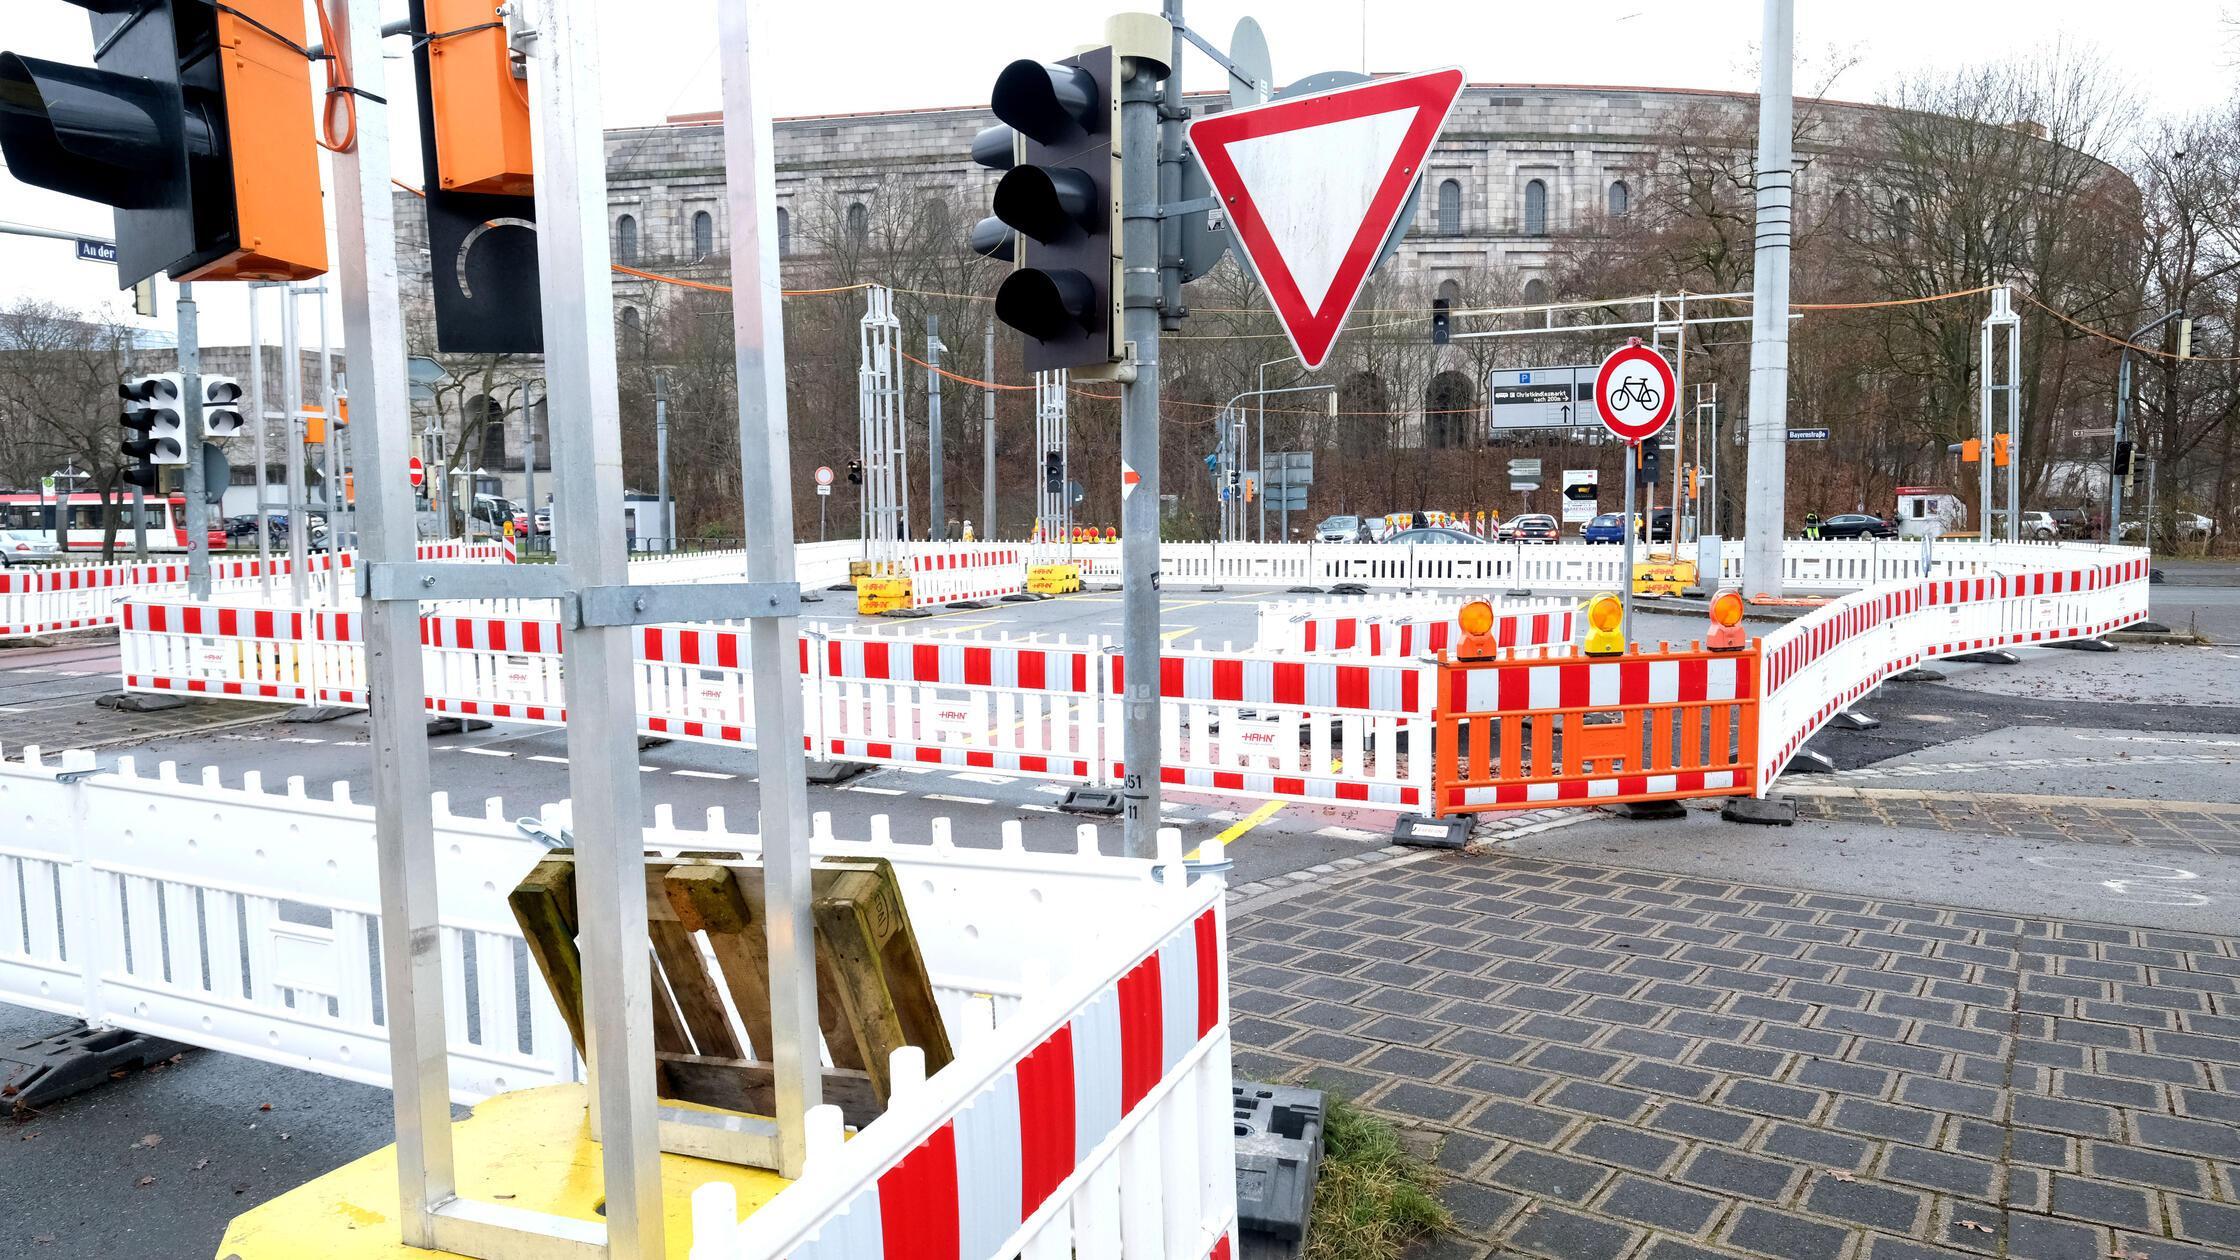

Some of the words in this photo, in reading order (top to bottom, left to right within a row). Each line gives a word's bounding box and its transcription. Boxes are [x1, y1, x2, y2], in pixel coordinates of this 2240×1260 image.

[83, 245, 96, 257] An
[98, 245, 115, 259] der
[1789, 431, 1826, 439] Bayernstraße
[1128, 805, 1138, 819] 11
